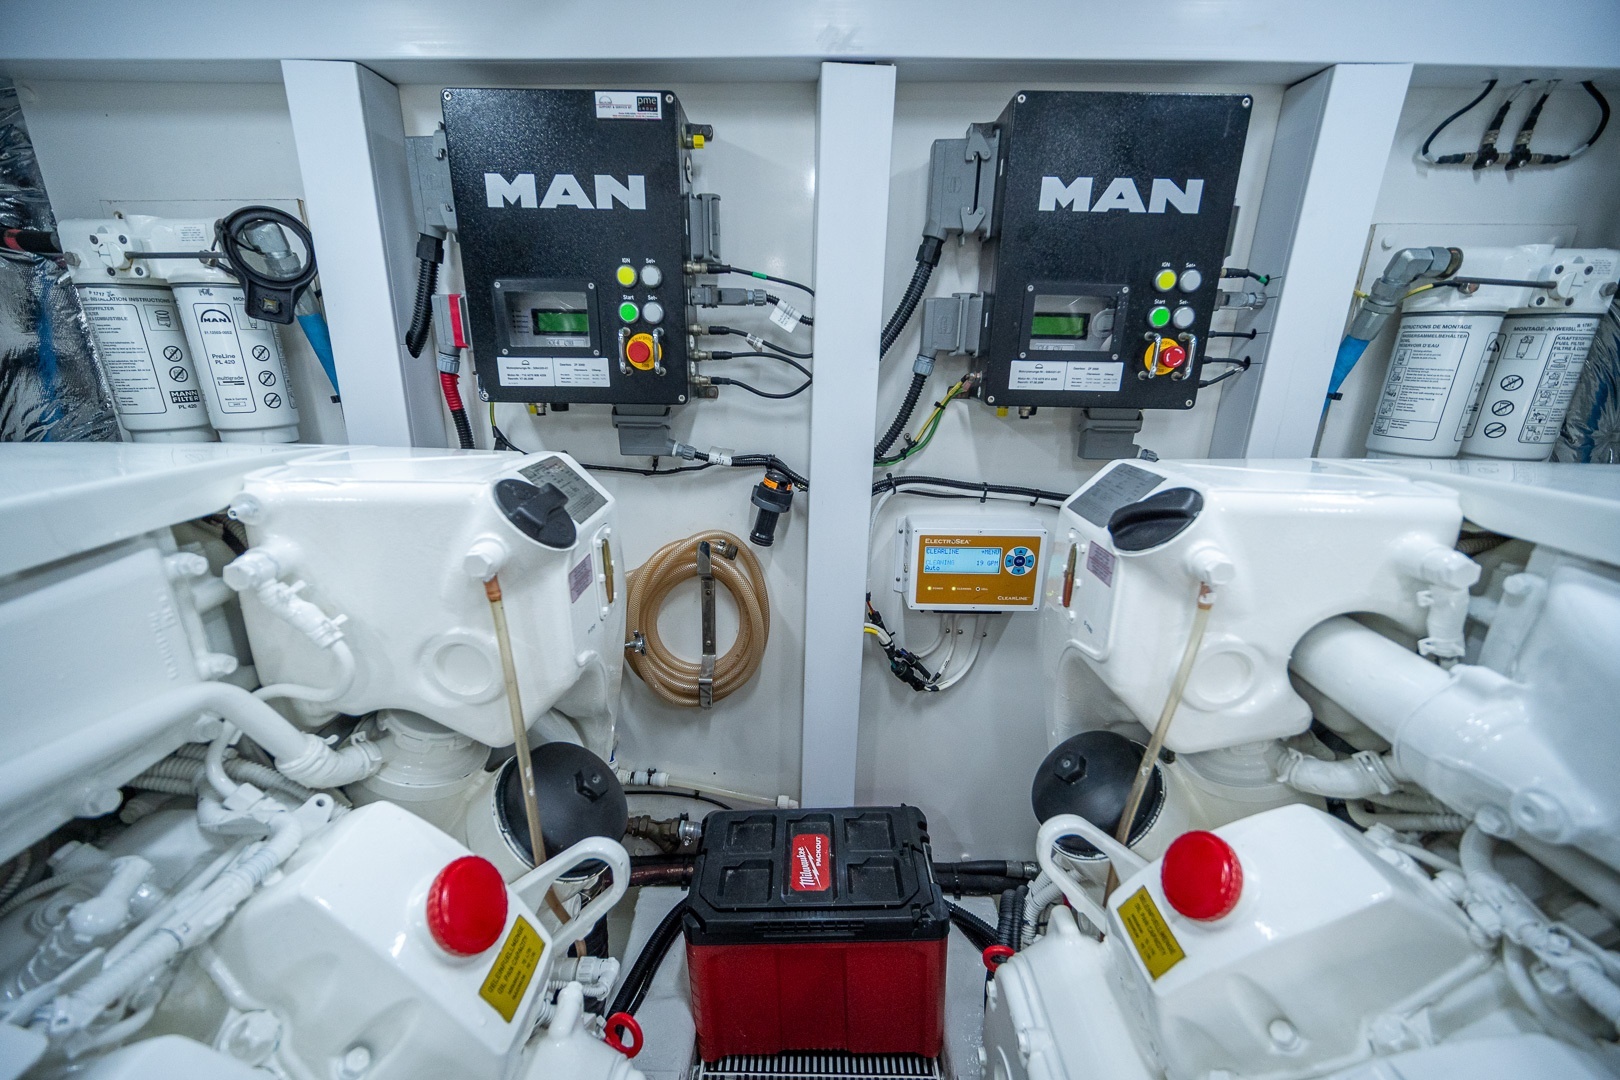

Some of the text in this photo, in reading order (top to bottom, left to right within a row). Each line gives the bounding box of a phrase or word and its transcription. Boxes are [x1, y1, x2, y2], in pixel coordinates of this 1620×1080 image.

[638, 97, 657, 106] pme
[484, 173, 646, 210] MAN
[1038, 176, 1204, 214] MAN
[796, 847, 815, 888] Milwaukee
